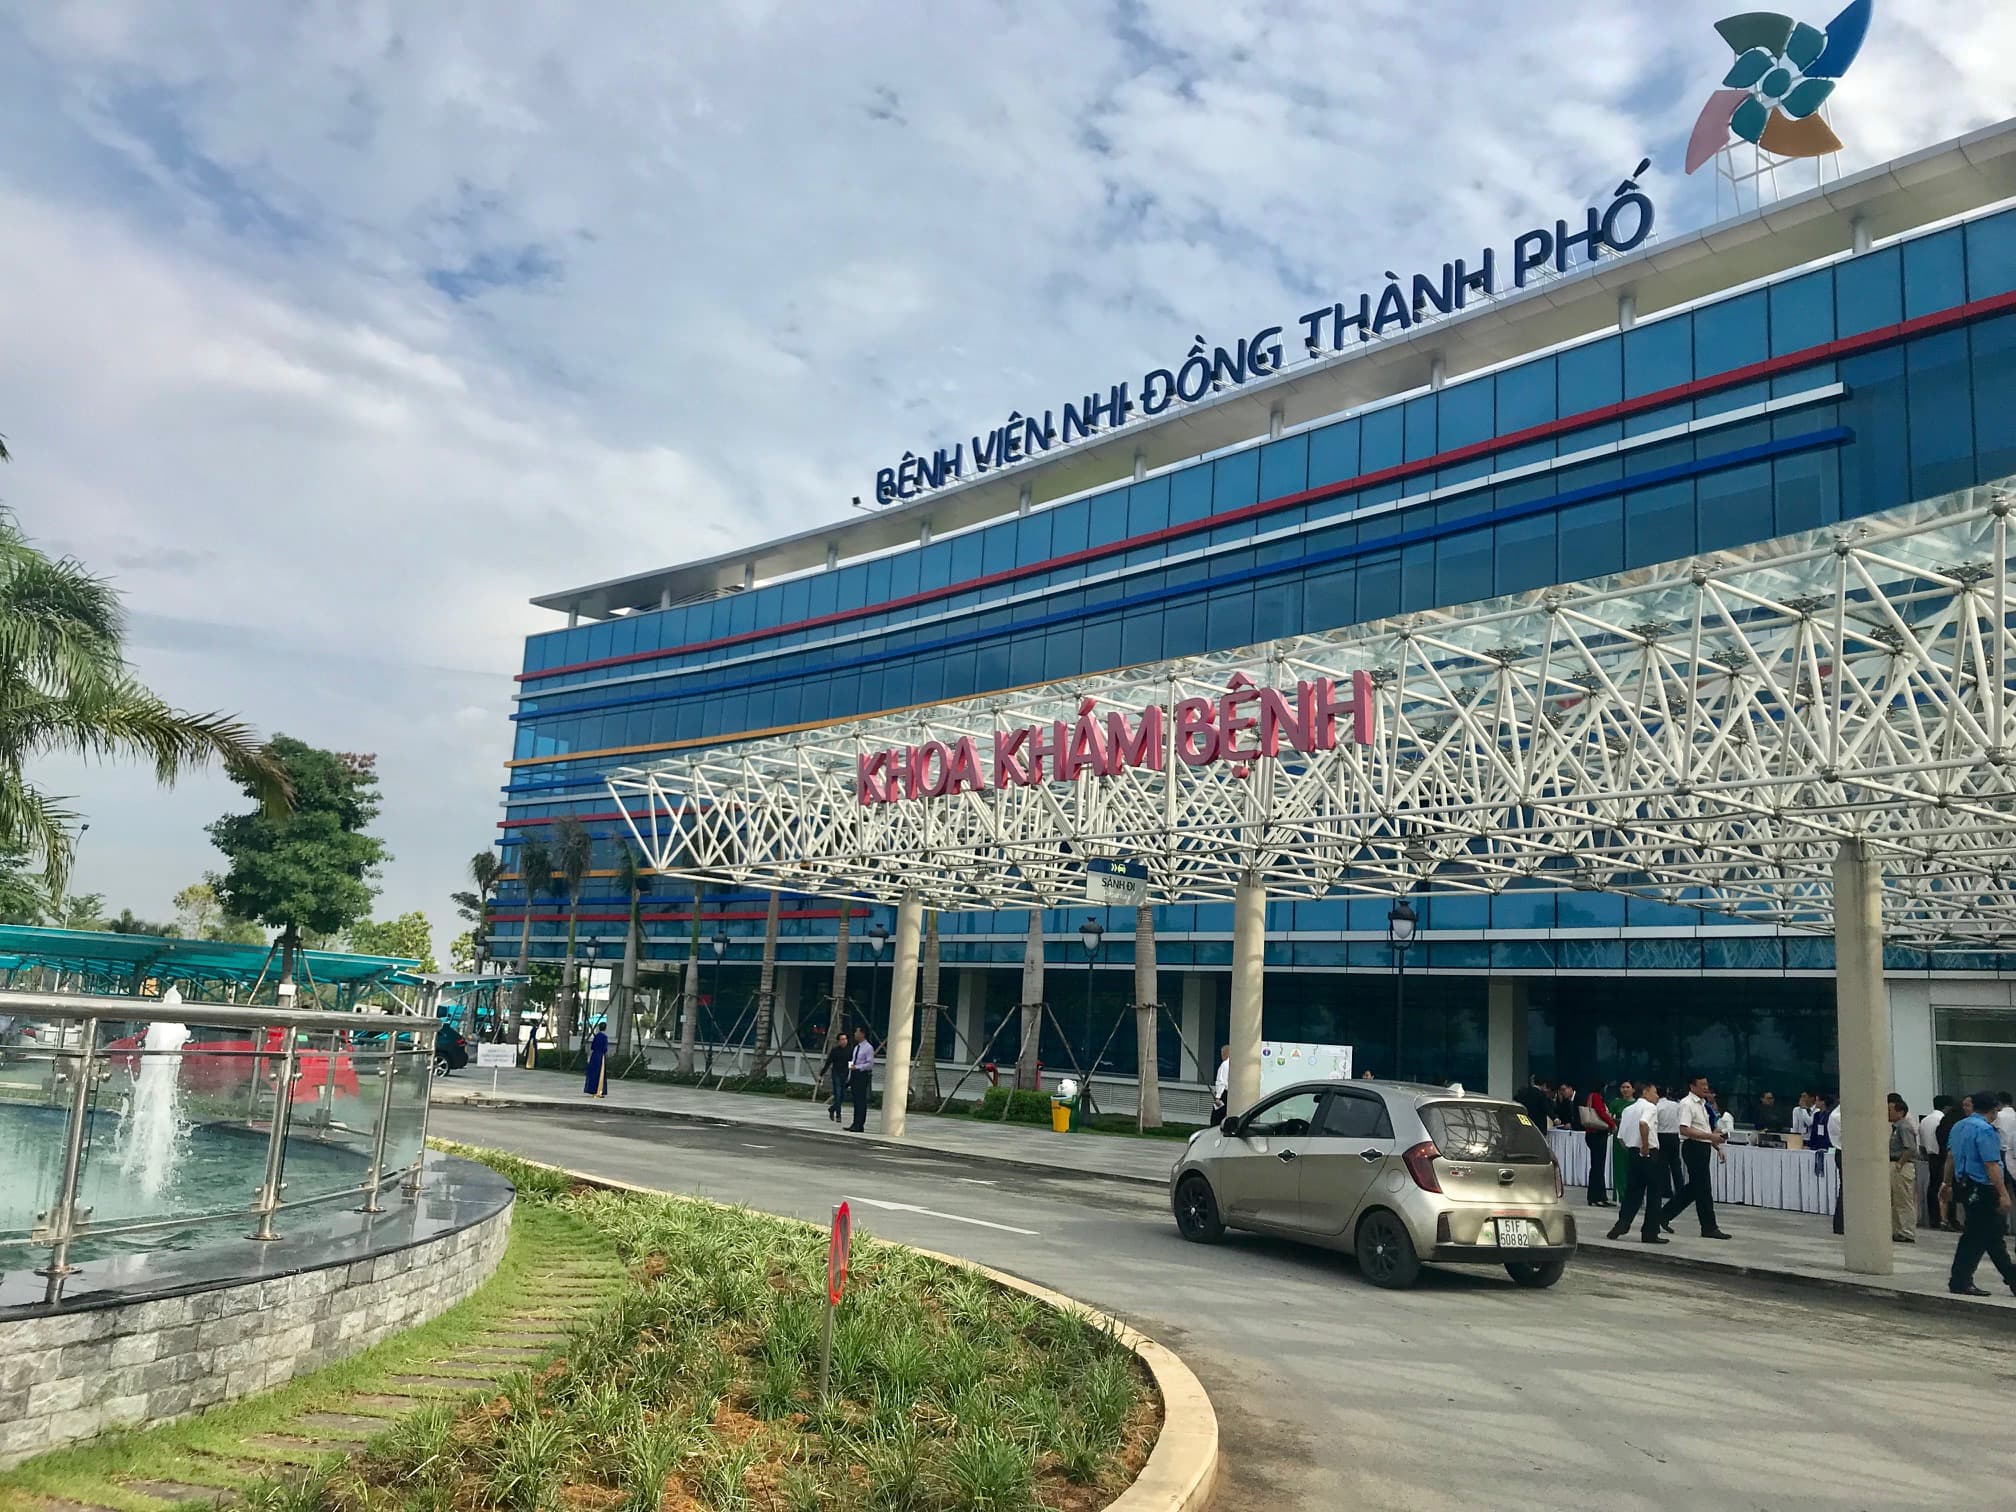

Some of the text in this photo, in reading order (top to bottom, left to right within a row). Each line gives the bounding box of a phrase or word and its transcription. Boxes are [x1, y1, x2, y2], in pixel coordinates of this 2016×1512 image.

[1062, 381, 1130, 443] NHI
[1140, 325, 1283, 415] ĐỒNG
[1299, 247, 1495, 359] THÀNH
[1514, 157, 1656, 289] PHỐ
[858, 670, 1373, 806] KHOA KHÁM BỆNH
[1505, 1220, 1520, 1232] 51F
